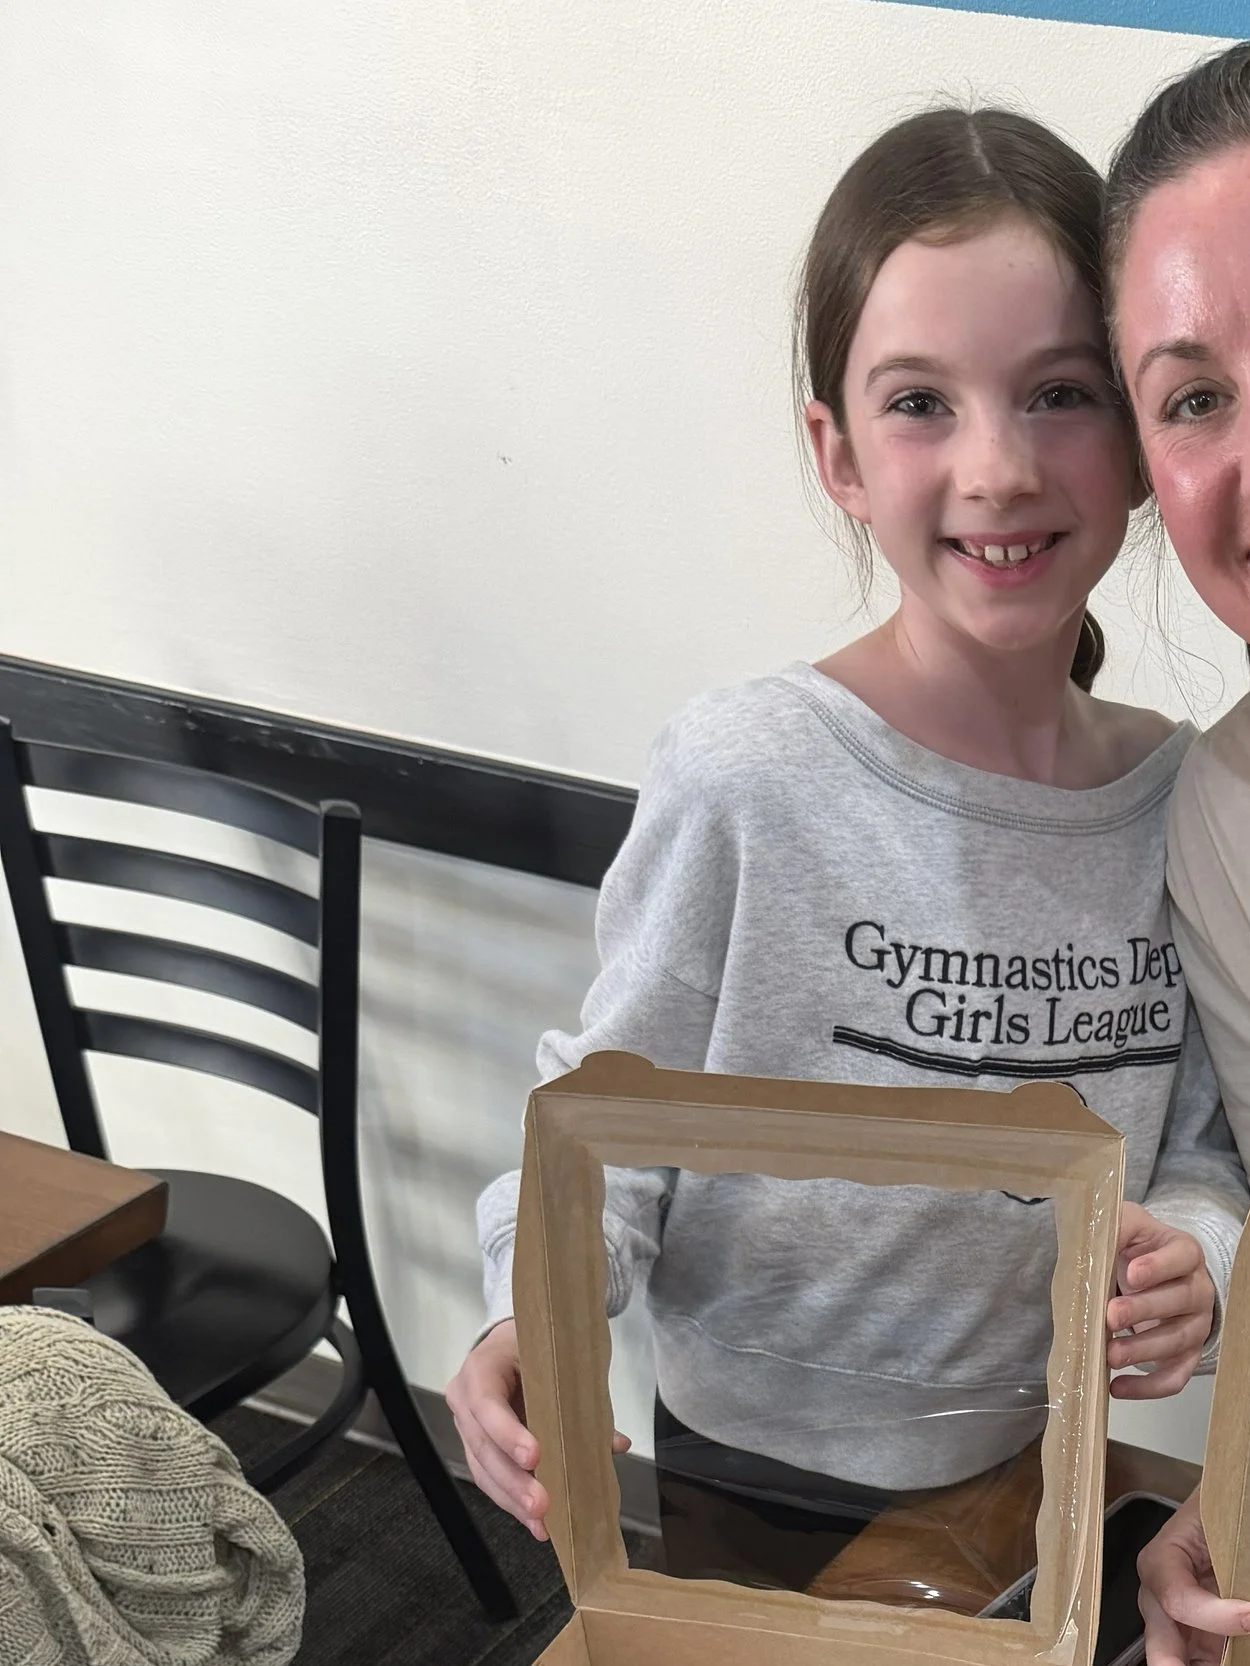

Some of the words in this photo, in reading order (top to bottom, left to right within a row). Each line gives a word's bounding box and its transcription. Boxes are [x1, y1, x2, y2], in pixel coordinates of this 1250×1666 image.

[844, 920, 1120, 992] Gymnastics
[1126, 936, 1183, 987] Dep
[905, 988, 1030, 1046] Girls
[1043, 996, 1172, 1049] League
